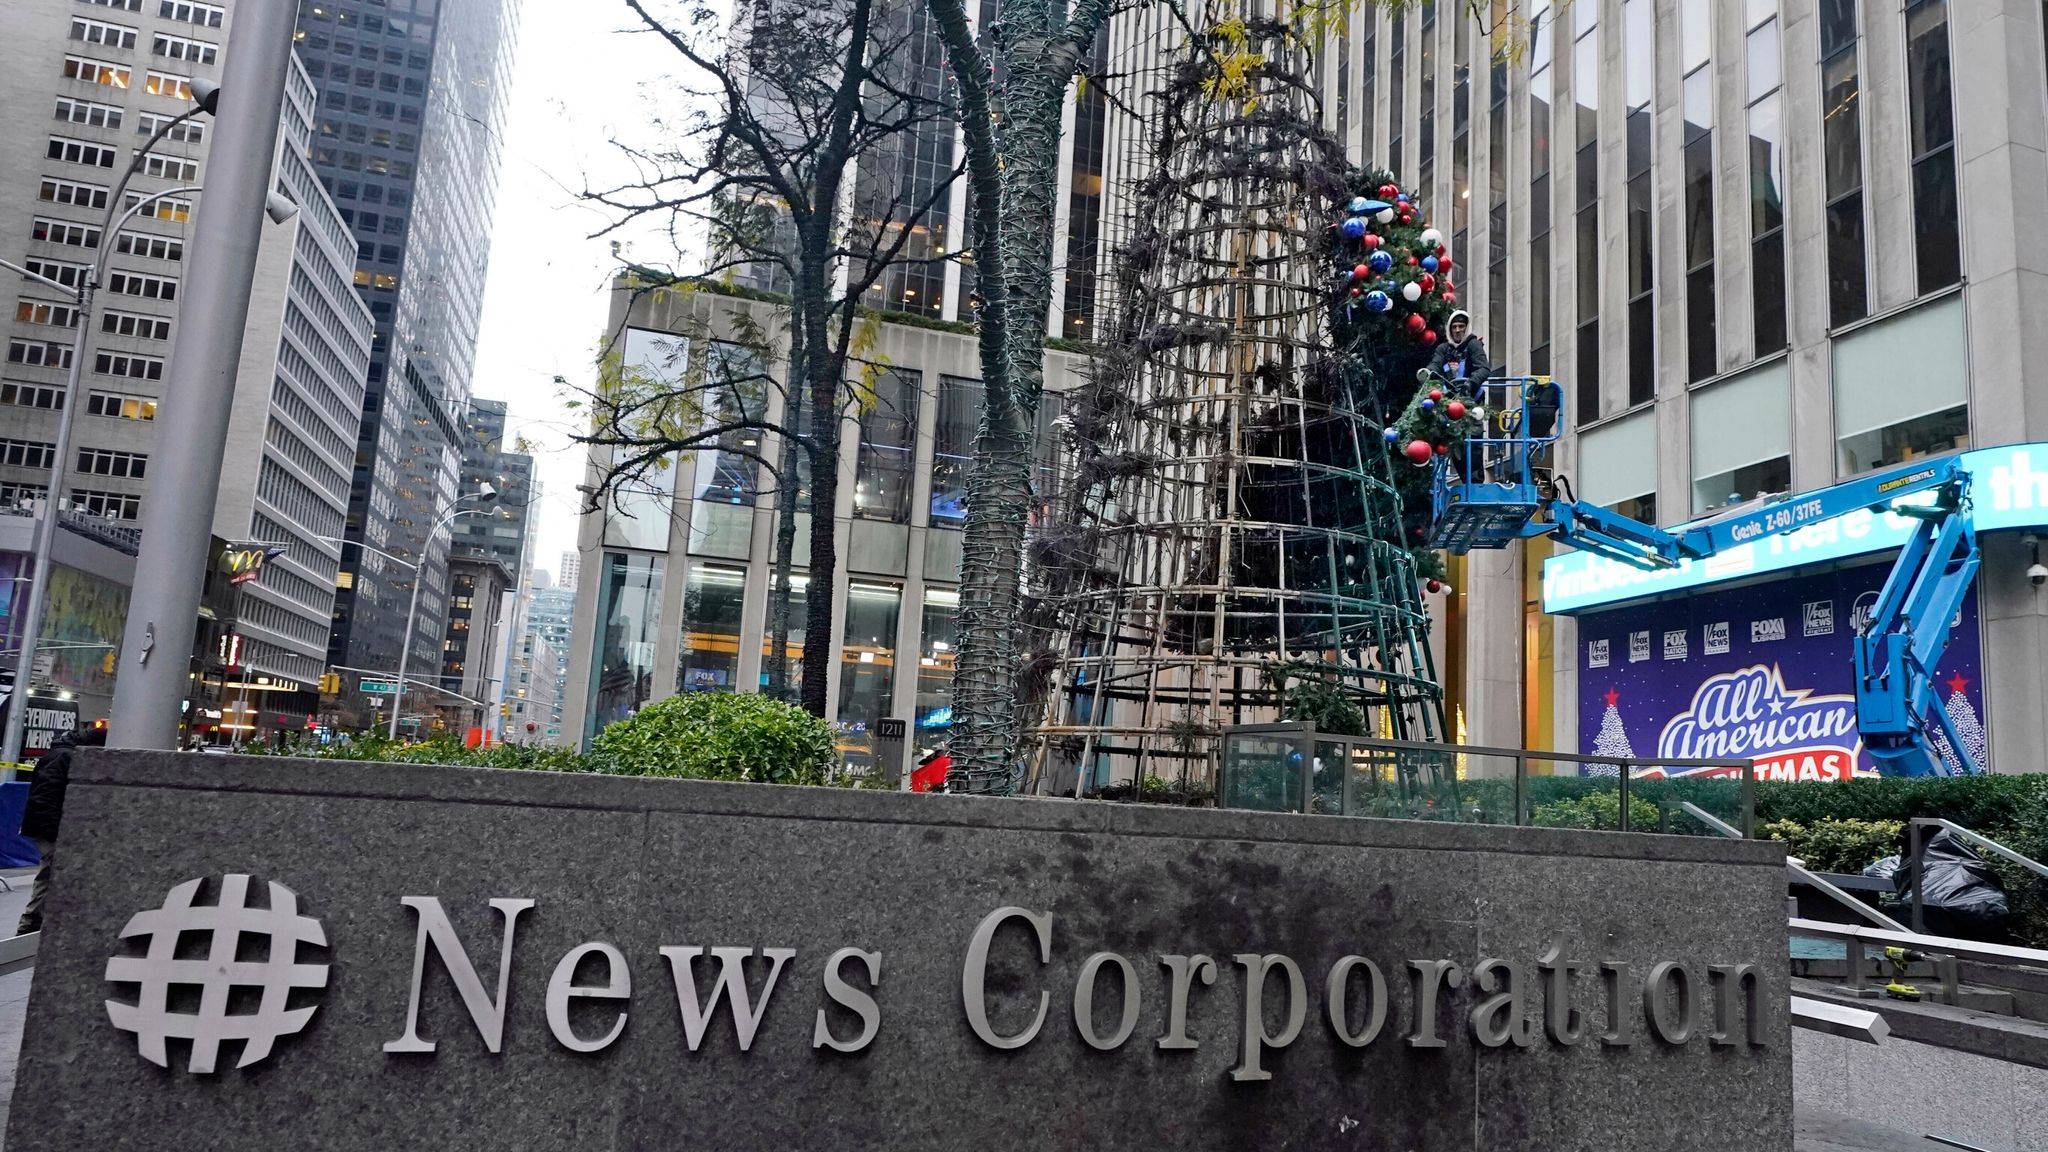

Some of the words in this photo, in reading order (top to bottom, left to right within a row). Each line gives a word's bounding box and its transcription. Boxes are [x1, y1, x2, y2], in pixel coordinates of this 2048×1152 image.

[1731, 520, 1763, 541] Genie
[1765, 499, 1823, 531] Z-60/37FE
[1813, 608, 1831, 618] FOX
[1751, 618, 1779, 636] FOX
[1808, 617, 1832, 628] NEWS
[1664, 631, 1687, 647] FOX
[1712, 629, 1728, 638] FOX
[1707, 637, 1729, 648] NEWS
[695, 671, 715, 680] FOX
[1698, 675, 1765, 730] All
[881, 723, 903, 736] 1211
[1664, 706, 1856, 759] American
[383, 896, 882, 1054] News
[962, 905, 1770, 1082] Corporation
